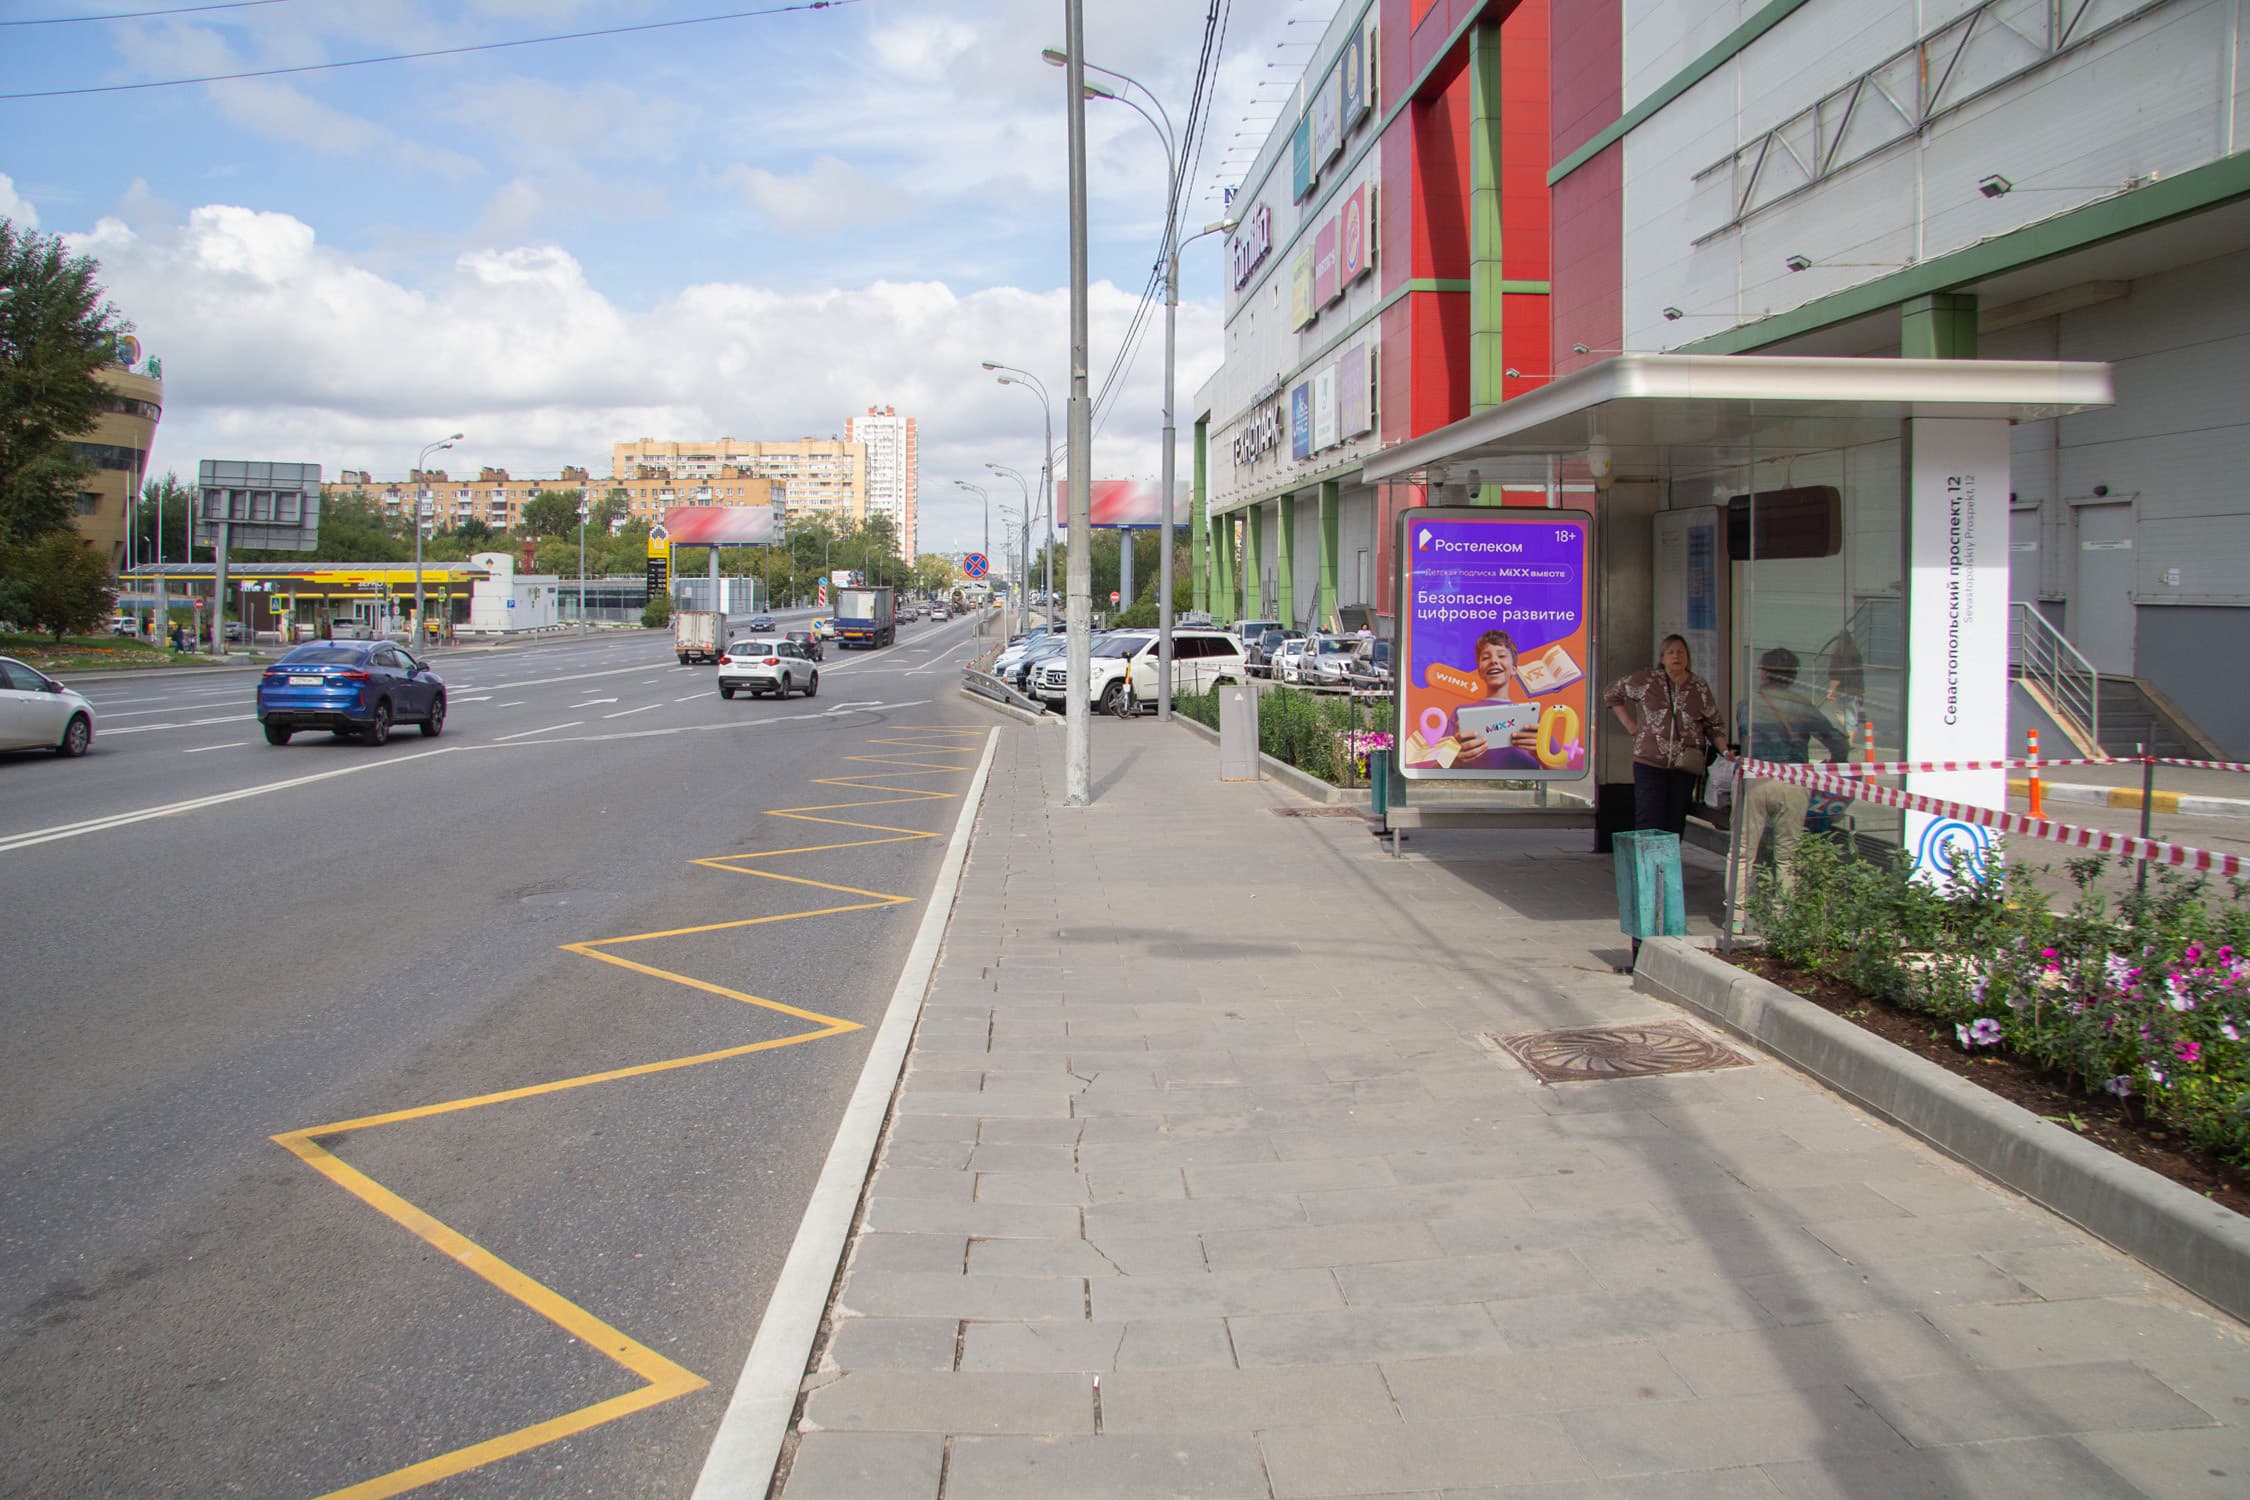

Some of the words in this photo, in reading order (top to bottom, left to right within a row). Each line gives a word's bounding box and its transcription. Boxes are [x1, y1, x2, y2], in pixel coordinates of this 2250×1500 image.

[1947, 476, 1960, 492] 12
[1965, 475, 1975, 486] 12
[1555, 530, 1577, 543] 18+
[1950, 496, 1962, 575] проспект,
[1435, 539, 1523, 553] Ростелеком
[1459, 569, 1497, 578] подписка
[1418, 591, 1513, 605] Безопасное
[1418, 606, 1498, 622] цифровое
[1502, 609, 1575, 623] развитие
[1944, 581, 1960, 725] Севастопольский
